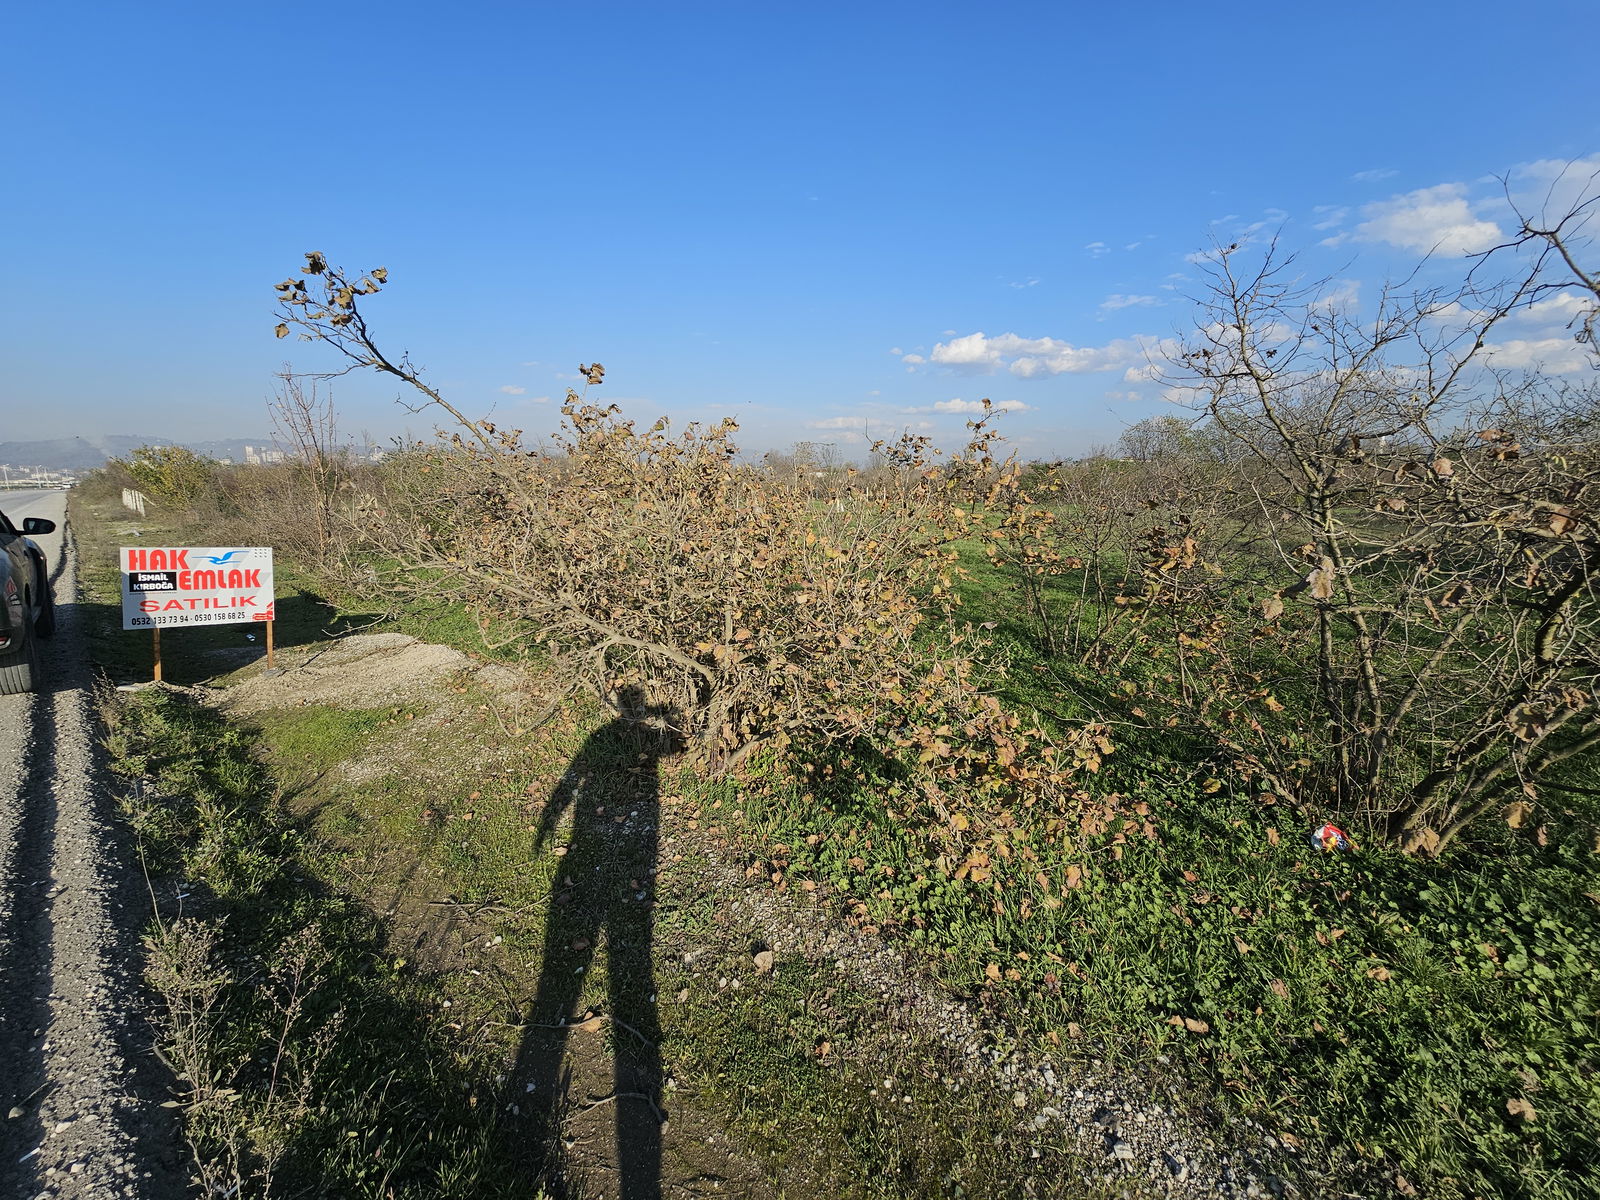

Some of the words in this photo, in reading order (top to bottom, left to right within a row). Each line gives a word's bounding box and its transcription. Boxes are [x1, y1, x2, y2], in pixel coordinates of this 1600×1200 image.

[128, 550, 190, 570] HAK
[178, 569, 261, 590] EMLAK
[139, 595, 257, 612] SATILIK
[131, 617, 151, 625] 0532
[153, 616, 167, 624] 133
[168, 615, 178, 623] 73
[179, 614, 189, 622] 94
[194, 613, 212, 621] 0530
[214, 612, 226, 620] 158
[237, 611, 246, 619] 25
